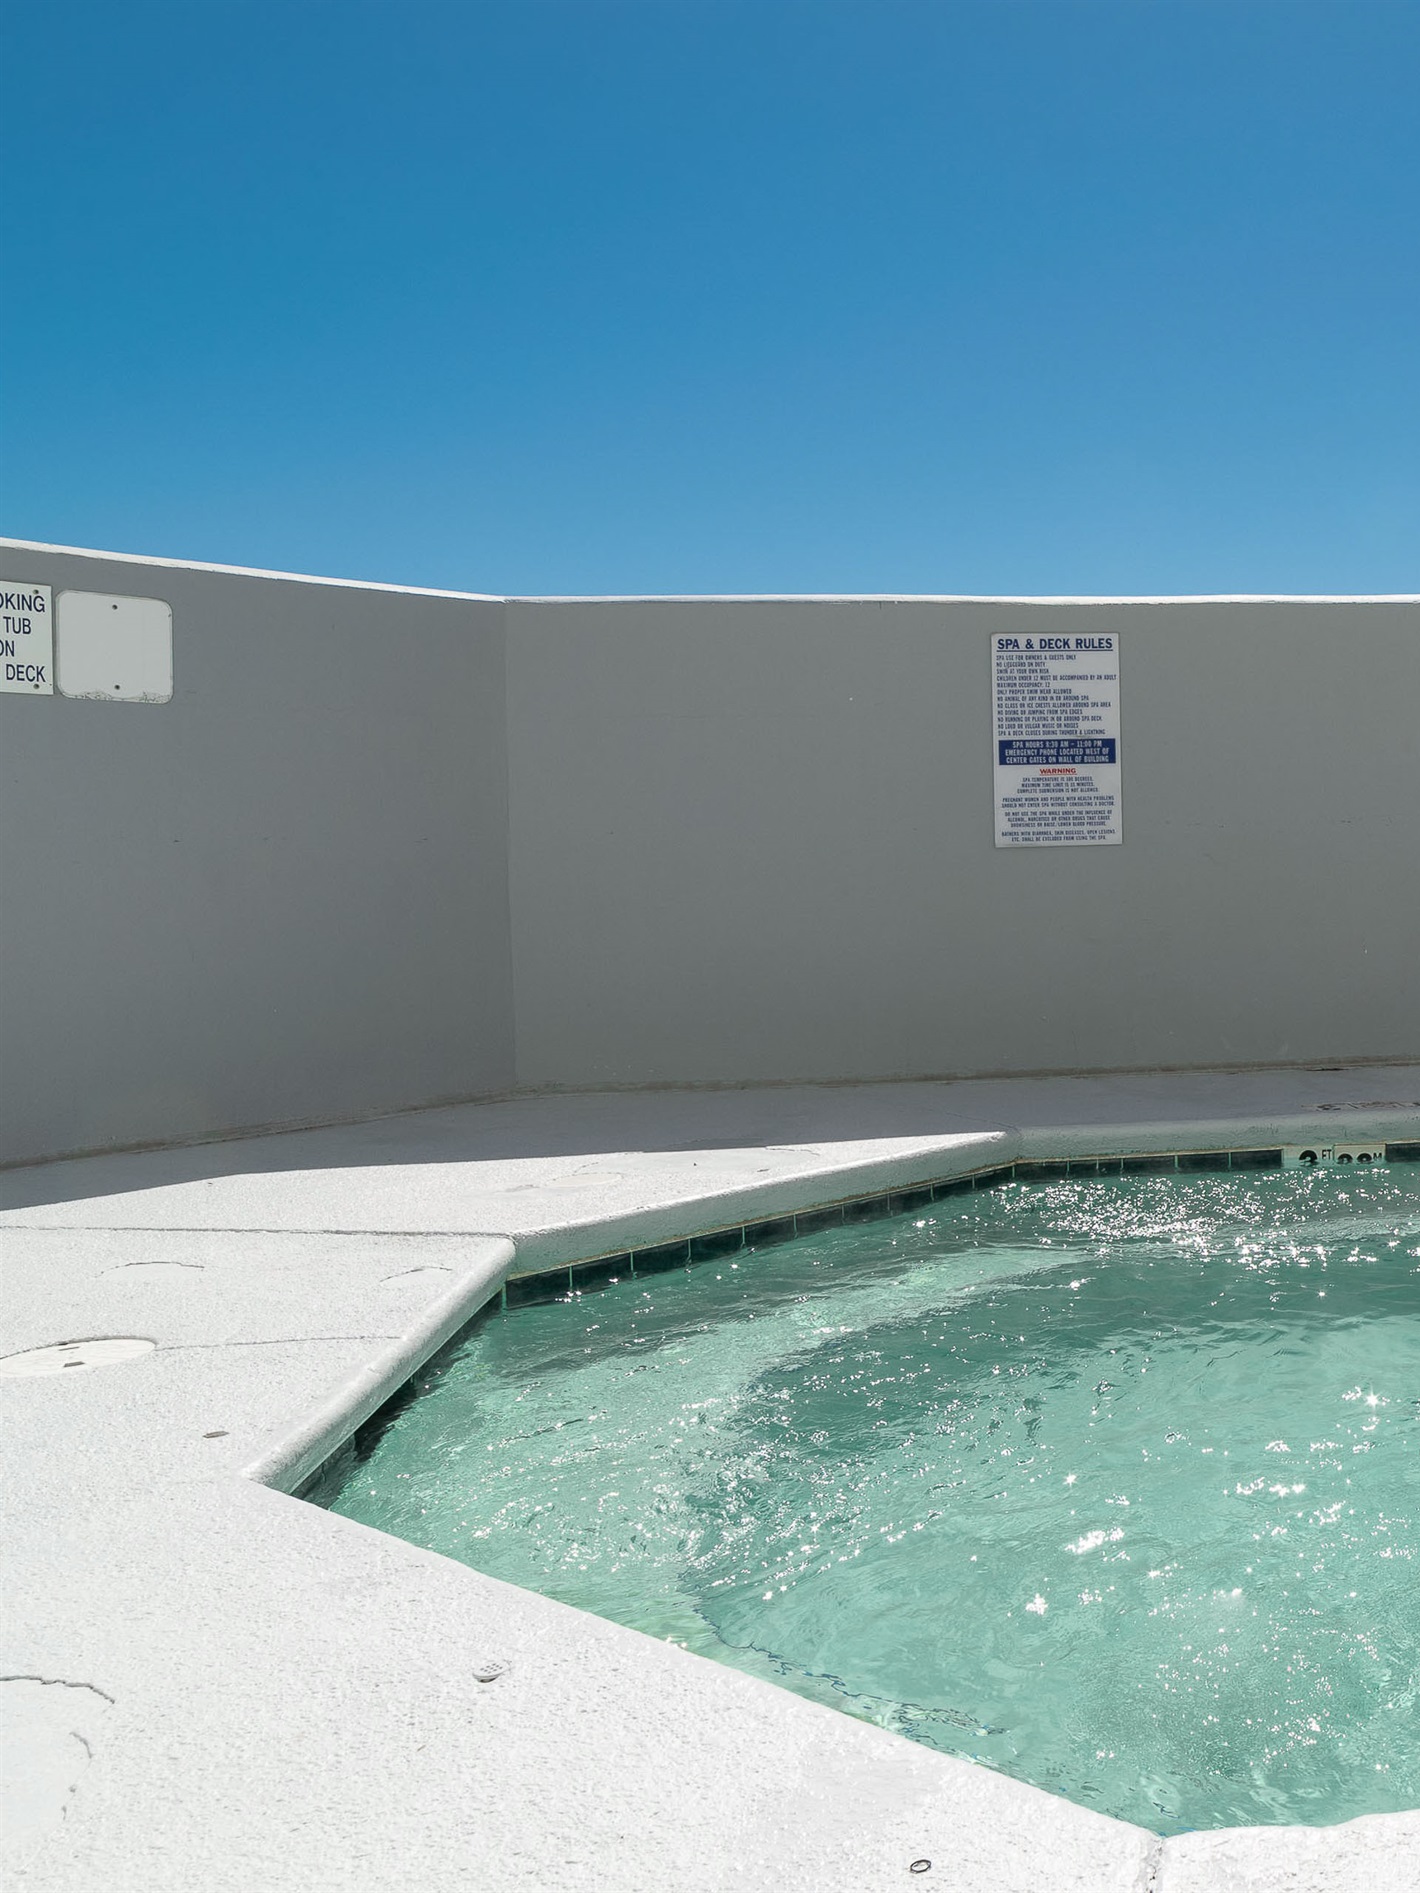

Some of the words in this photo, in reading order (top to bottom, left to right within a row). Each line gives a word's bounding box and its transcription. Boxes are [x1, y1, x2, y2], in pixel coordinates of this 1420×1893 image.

[0, 593, 45, 613] KING
[3, 616, 32, 635] TUB
[997, 638, 1019, 649] SPA
[1025, 638, 1034, 649] &
[1039, 638, 1070, 649] DECK
[1075, 638, 1113, 649] RULES
[6, 664, 46, 682] DECK
